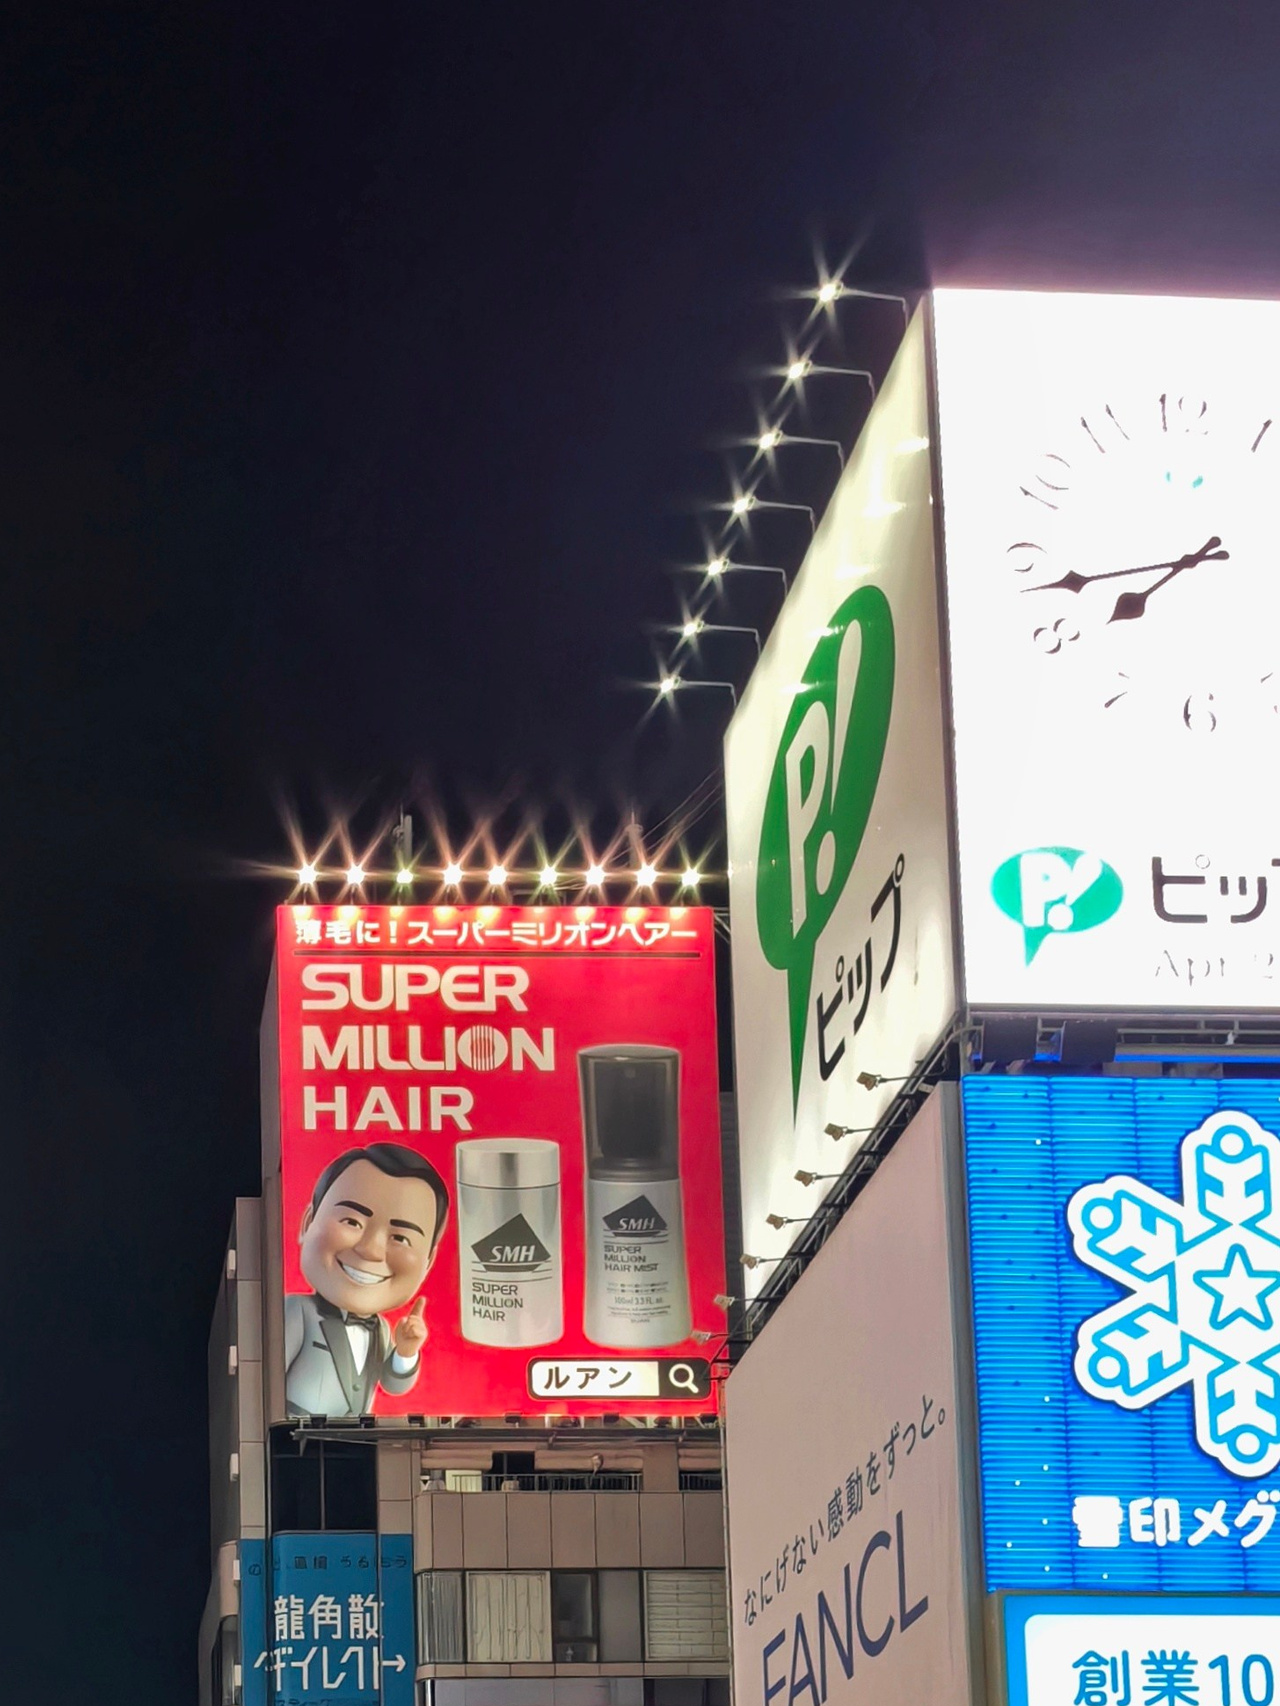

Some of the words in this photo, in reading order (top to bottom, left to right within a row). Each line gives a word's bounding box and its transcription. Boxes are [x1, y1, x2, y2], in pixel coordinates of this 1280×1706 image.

[1151, 853, 1280, 925] ピッ
[816, 852, 905, 1082] ピップ
[301, 963, 530, 1012] SUPER
[301, 1025, 556, 1072] MILLION
[301, 1085, 474, 1132] HAIR
[619, 1217, 656, 1231] SMH
[489, 1244, 536, 1262] SMH
[603, 1244, 642, 1255] SUPER
[603, 1253, 647, 1264] MILLION
[604, 1262, 632, 1272] HAIR
[471, 1281, 519, 1296] SUPER
[472, 1293, 524, 1309] MILLION
[472, 1305, 506, 1322] HAIR
[542, 1365, 634, 1393] ルアン
[743, 1394, 947, 1626] なにげない感動をずっと。
[273, 1593, 385, 1641] 龍角散
[253, 1645, 407, 1692] ダイレクト
